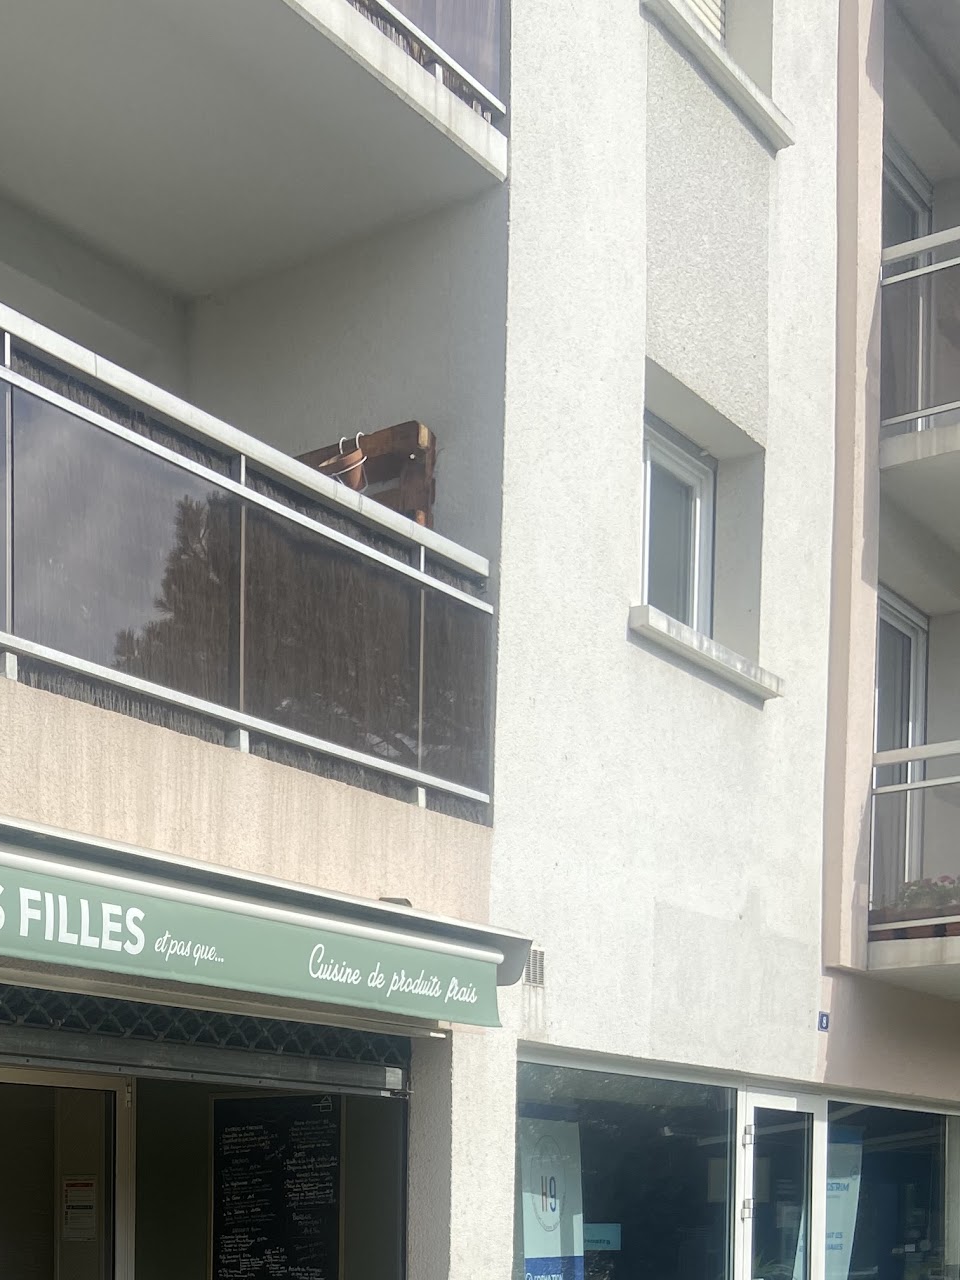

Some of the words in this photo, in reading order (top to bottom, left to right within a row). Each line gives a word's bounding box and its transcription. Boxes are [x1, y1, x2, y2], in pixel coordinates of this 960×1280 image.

[18, 887, 145, 955] FILLES
[154, 930, 171, 953] et
[165, 939, 192, 962] pas
[193, 943, 224, 966] que...
[308, 943, 361, 985] Cuisine
[367, 962, 386, 988] de
[386, 969, 442, 998] produits
[444, 976, 478, 1003] frais
[541, 1175, 556, 1212] H9
